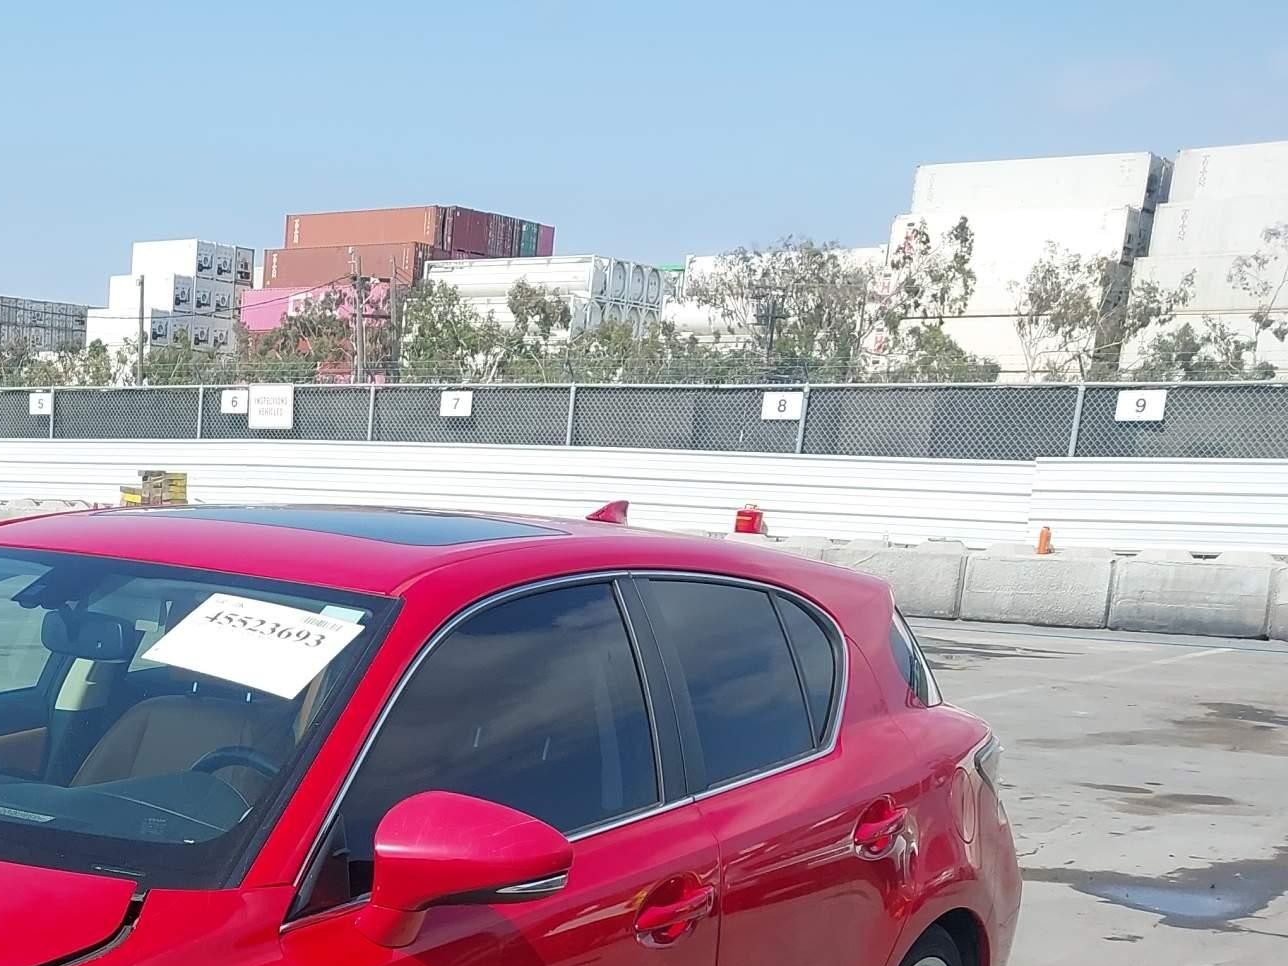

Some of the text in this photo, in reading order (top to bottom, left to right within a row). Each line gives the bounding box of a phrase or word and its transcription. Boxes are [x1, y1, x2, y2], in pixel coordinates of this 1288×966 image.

[37, 398, 44, 409] 5
[231, 396, 238, 408] 6
[452, 397, 461, 410] 7
[777, 399, 787, 413] 8
[1135, 398, 1147, 413] 9
[204, 609, 327, 649] 45523693
